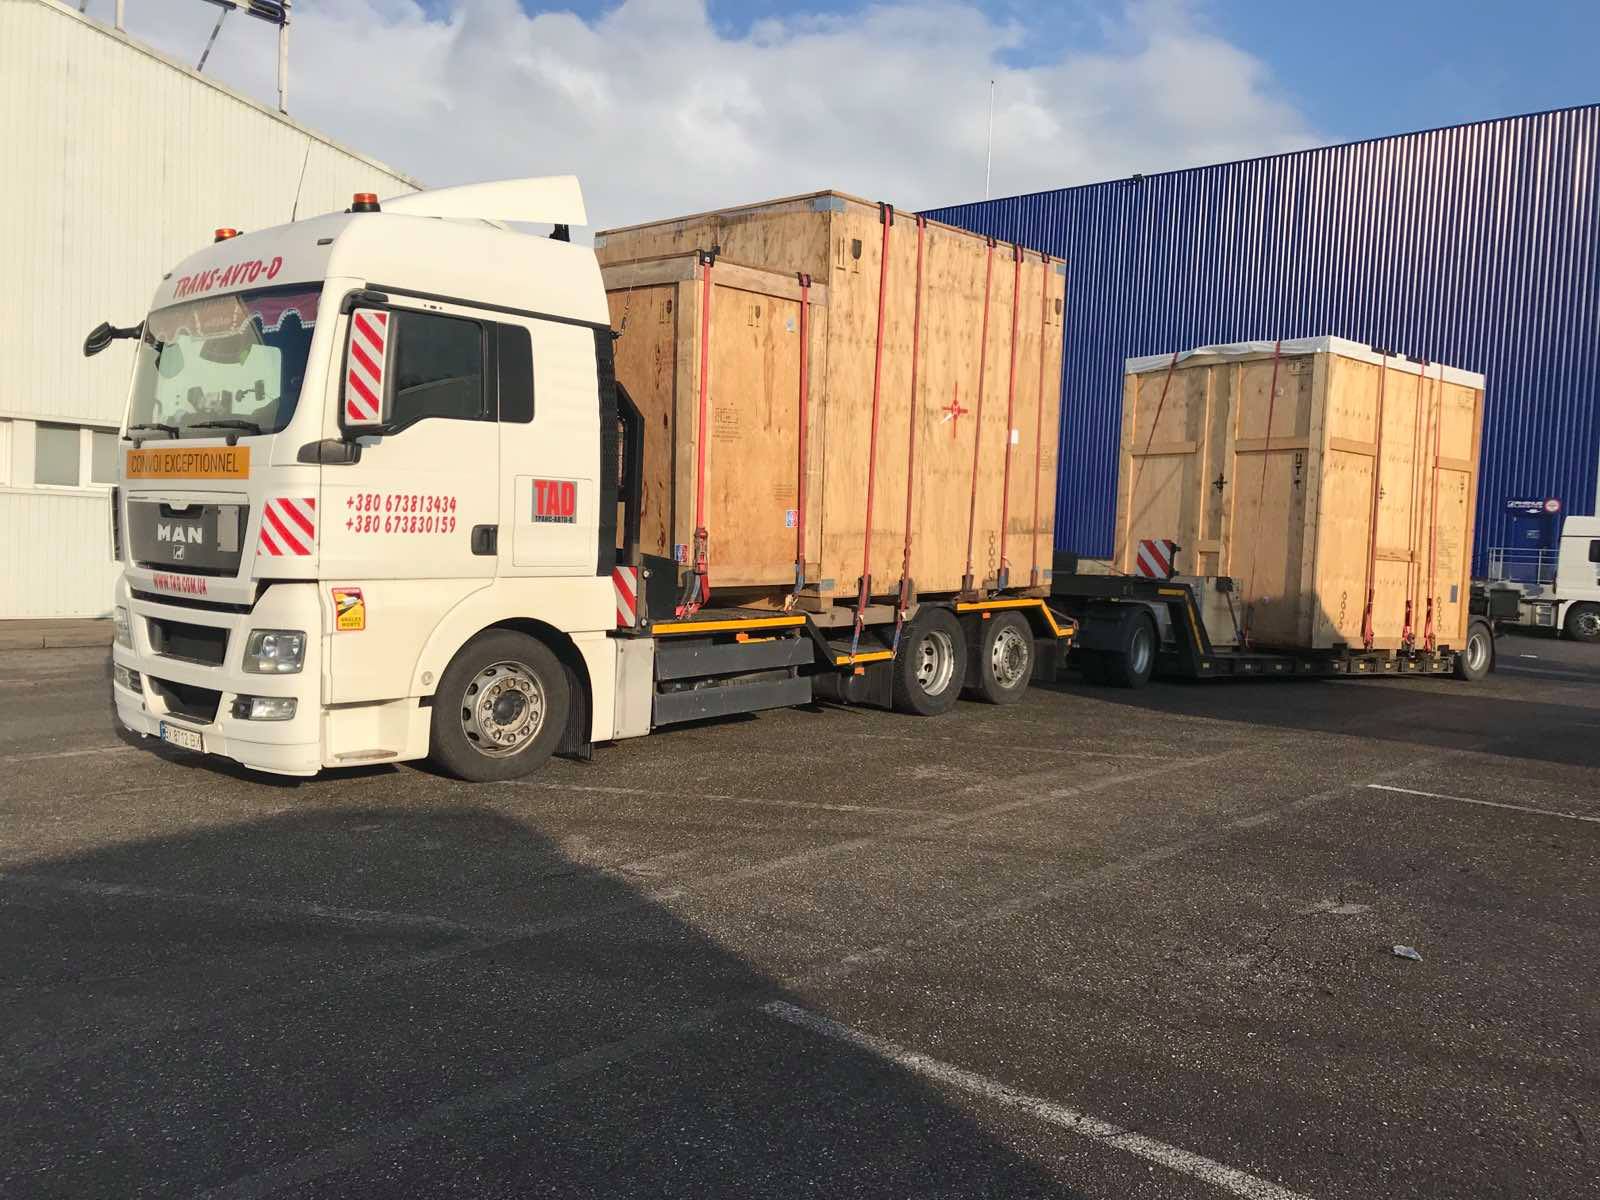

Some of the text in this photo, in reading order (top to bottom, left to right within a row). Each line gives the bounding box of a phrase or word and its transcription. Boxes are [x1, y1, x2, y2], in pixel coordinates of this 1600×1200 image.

[173, 256, 283, 298] TRANS-AVTO-D
[165, 453, 239, 472] EXCEPTIONNEL
[346, 493, 457, 513] +380 673813434
[534, 480, 575, 516] TAD
[157, 523, 203, 544] MAN
[345, 514, 456, 534] +380 673830159
